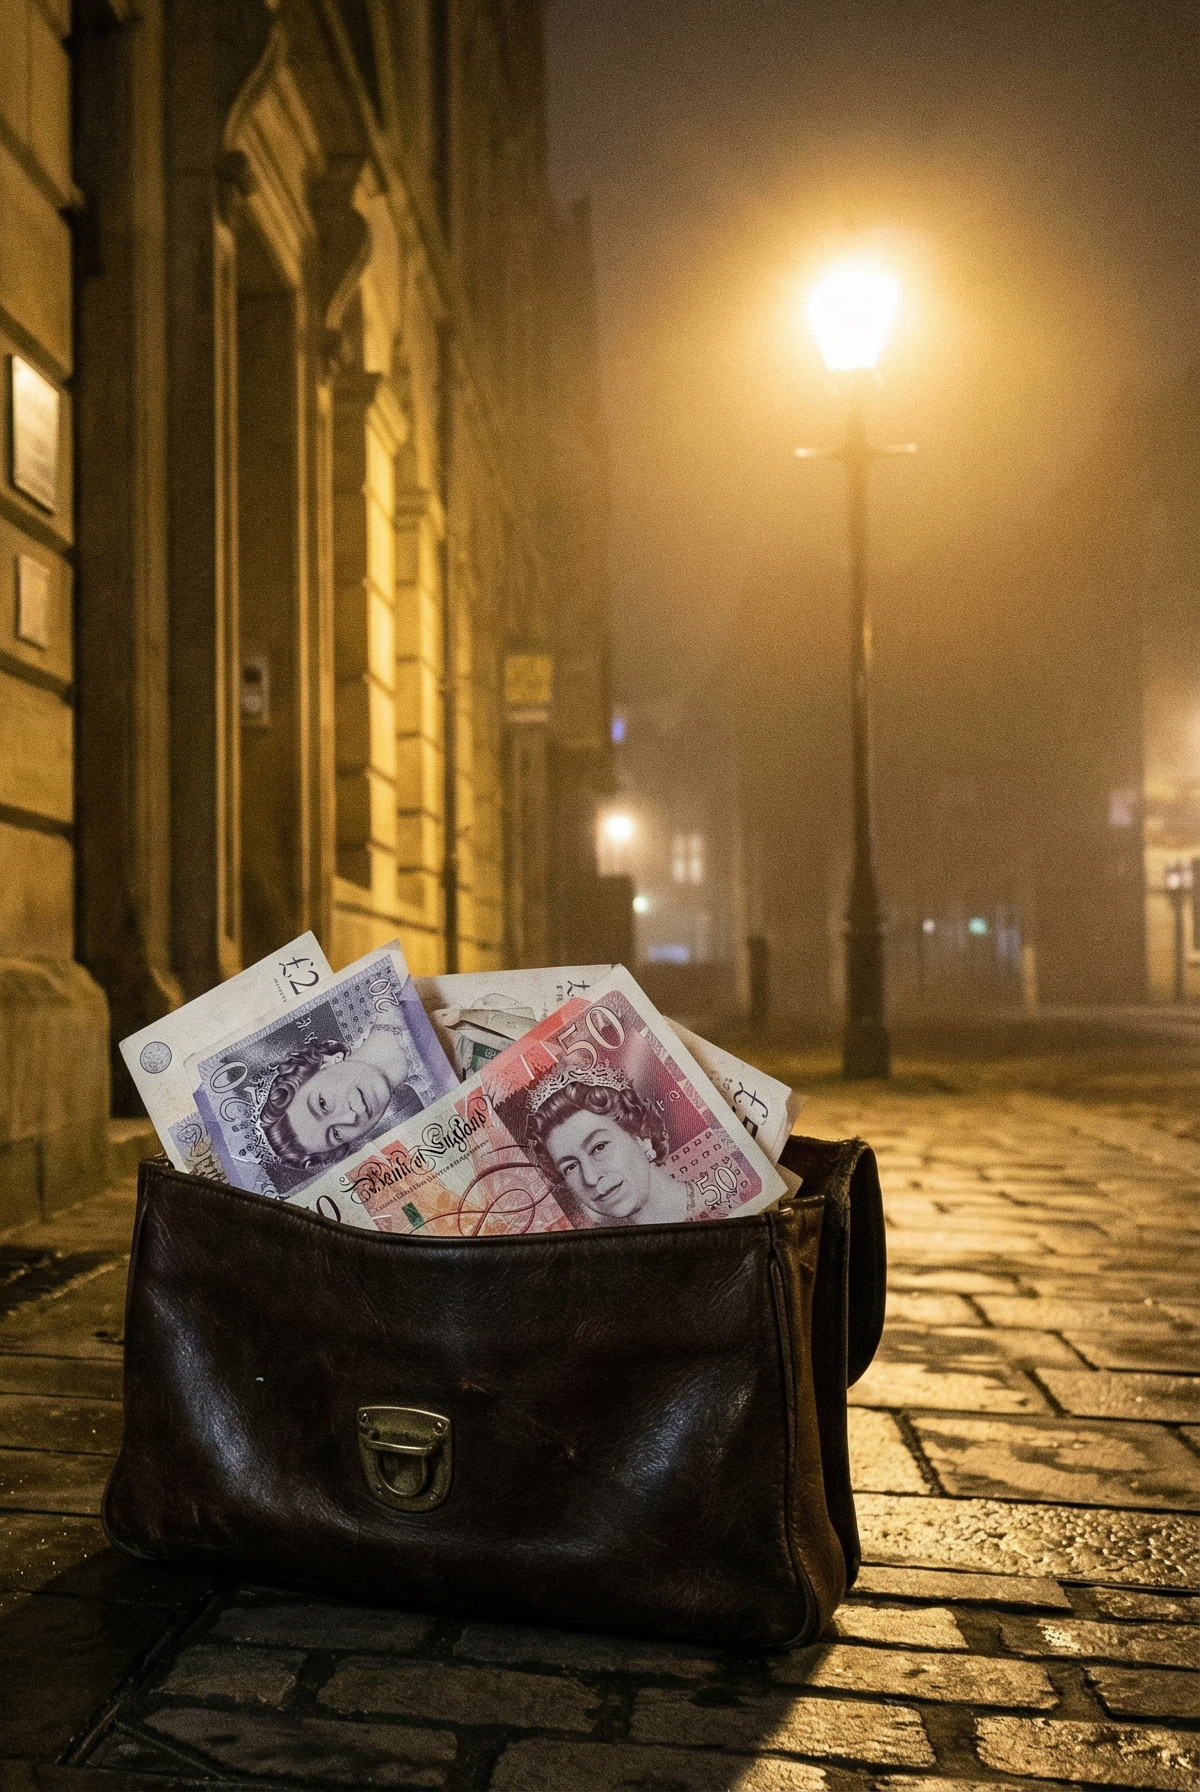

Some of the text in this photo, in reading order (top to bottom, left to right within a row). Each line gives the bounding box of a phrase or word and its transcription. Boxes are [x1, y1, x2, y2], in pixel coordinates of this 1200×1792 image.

[368, 977, 400, 1014] 20
[556, 1005, 626, 1075] 50
[695, 1165, 738, 1207] 50
